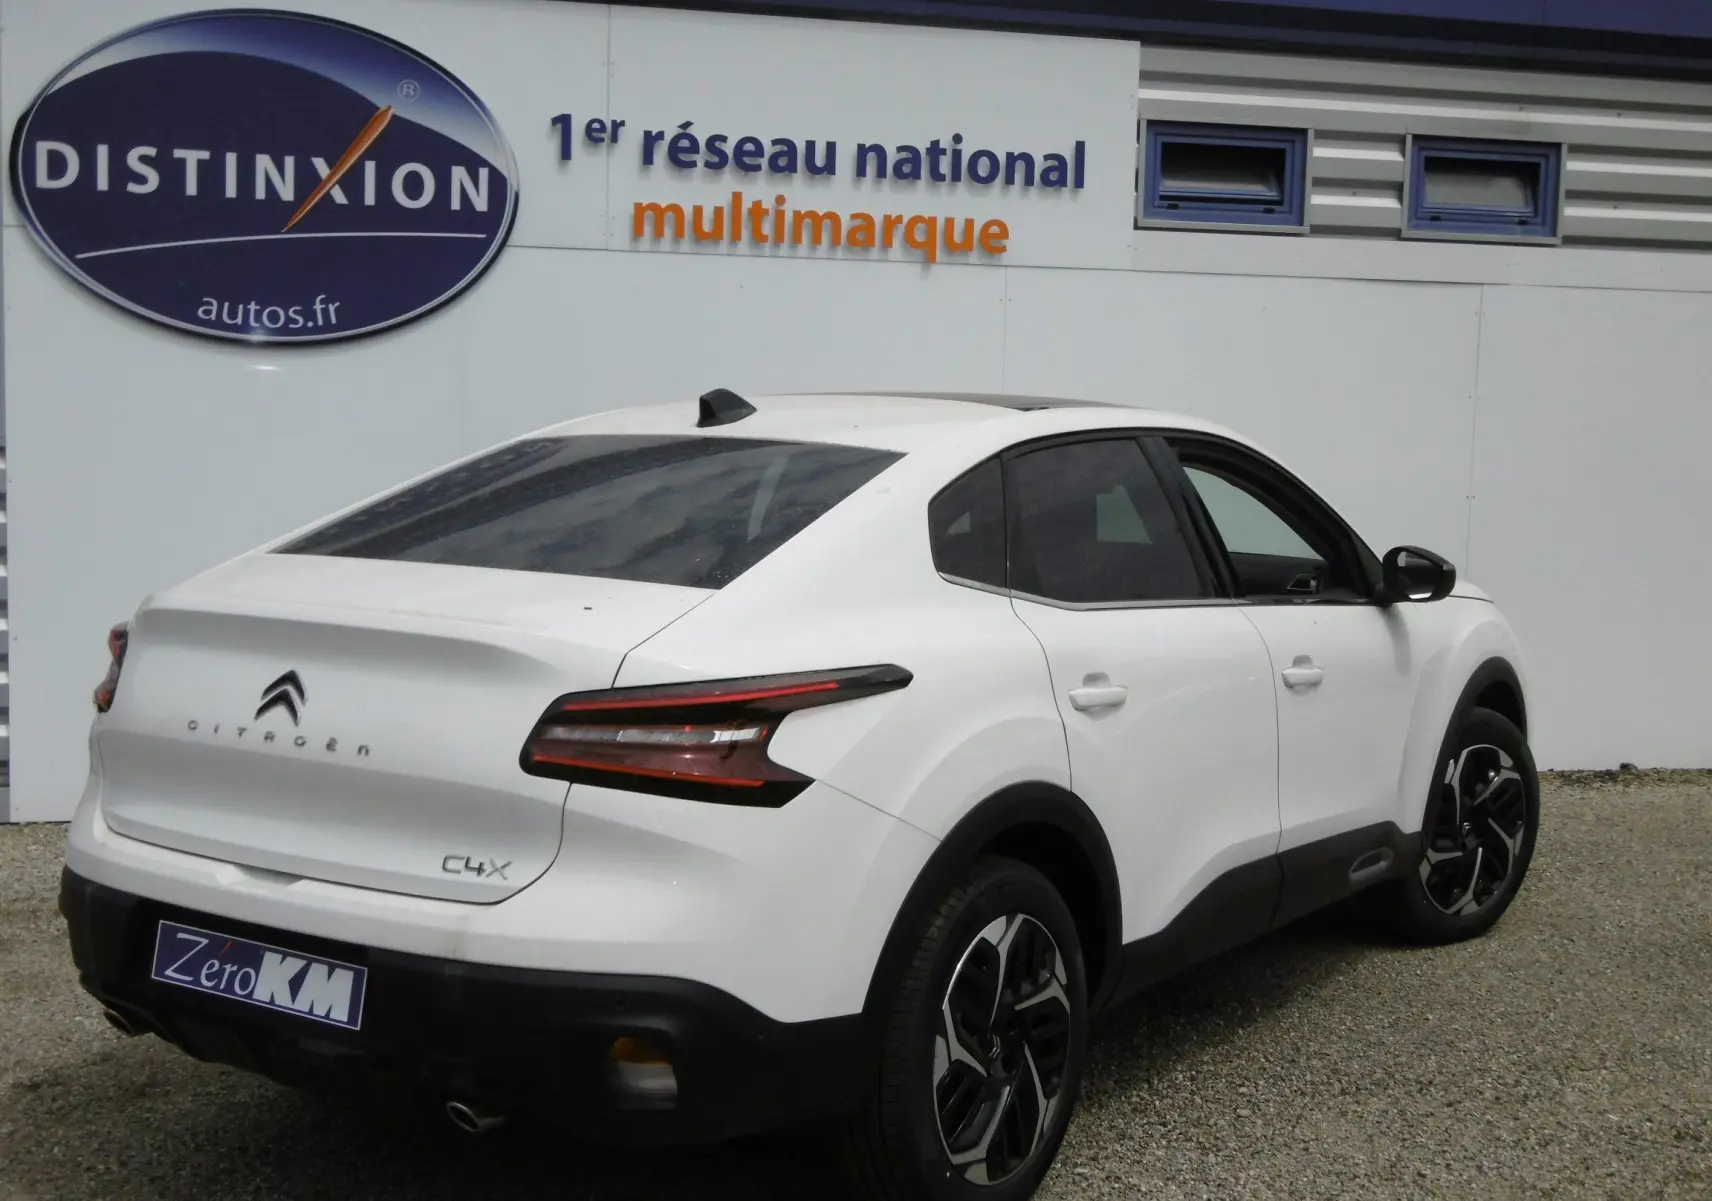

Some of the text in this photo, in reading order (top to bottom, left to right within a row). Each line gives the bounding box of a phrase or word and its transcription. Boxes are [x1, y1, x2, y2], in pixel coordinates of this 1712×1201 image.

[36, 140, 489, 212] DISTINXION
[550, 113, 1085, 189] 1er réseau national
[633, 191, 1009, 262] multimarque
[197, 295, 340, 329] autos.fr
